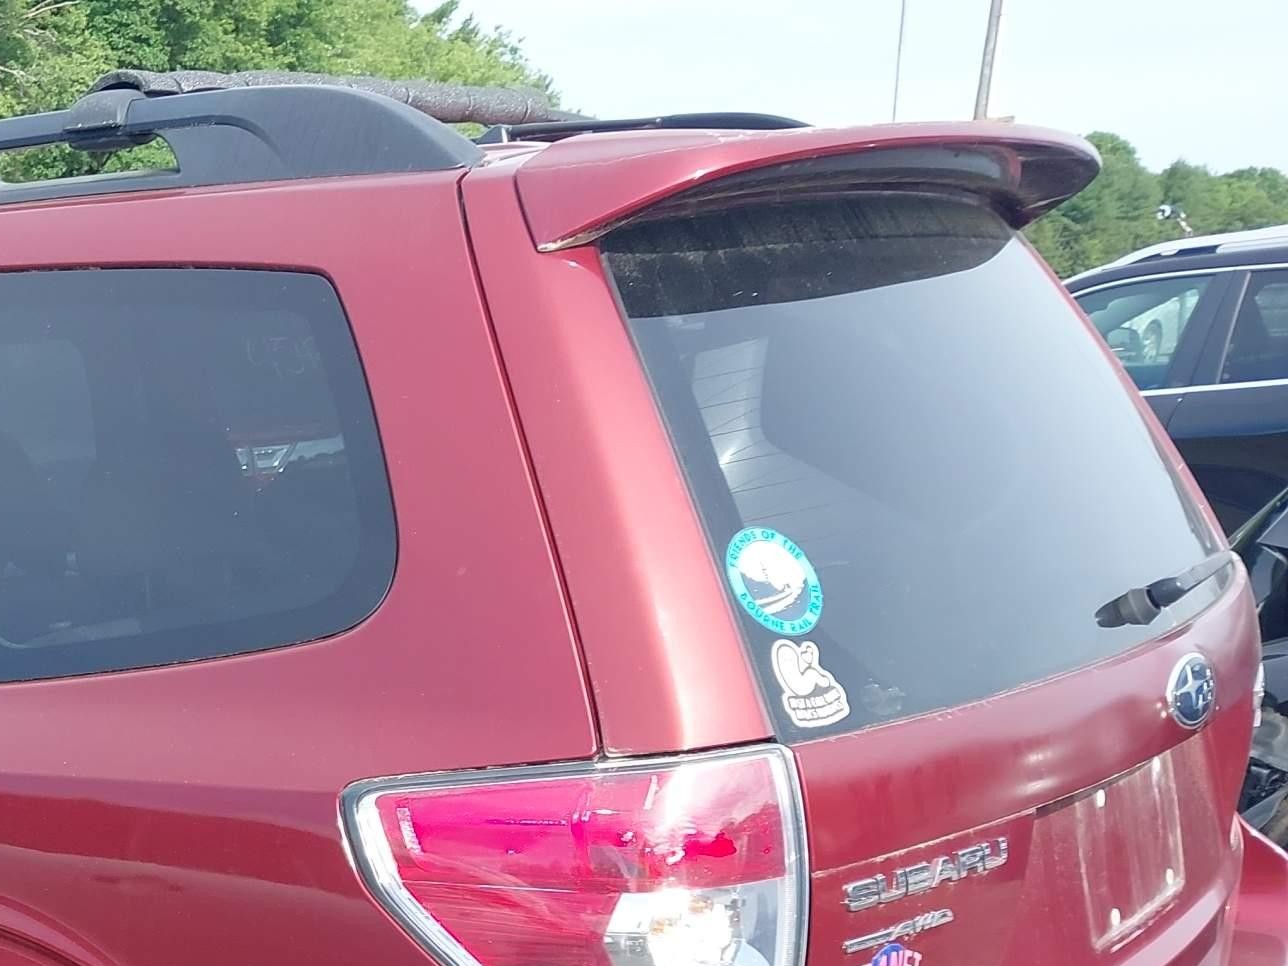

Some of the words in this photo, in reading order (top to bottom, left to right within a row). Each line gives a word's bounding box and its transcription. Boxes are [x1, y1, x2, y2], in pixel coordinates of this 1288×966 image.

[728, 530, 758, 568] FRIENDS
[760, 530, 777, 541] OF
[782, 539, 803, 561] THE
[739, 592, 785, 631] BOURNE
[789, 618, 813, 632] RAIL
[808, 584, 822, 616] TRAIL
[842, 838, 1009, 912] SUBARU
